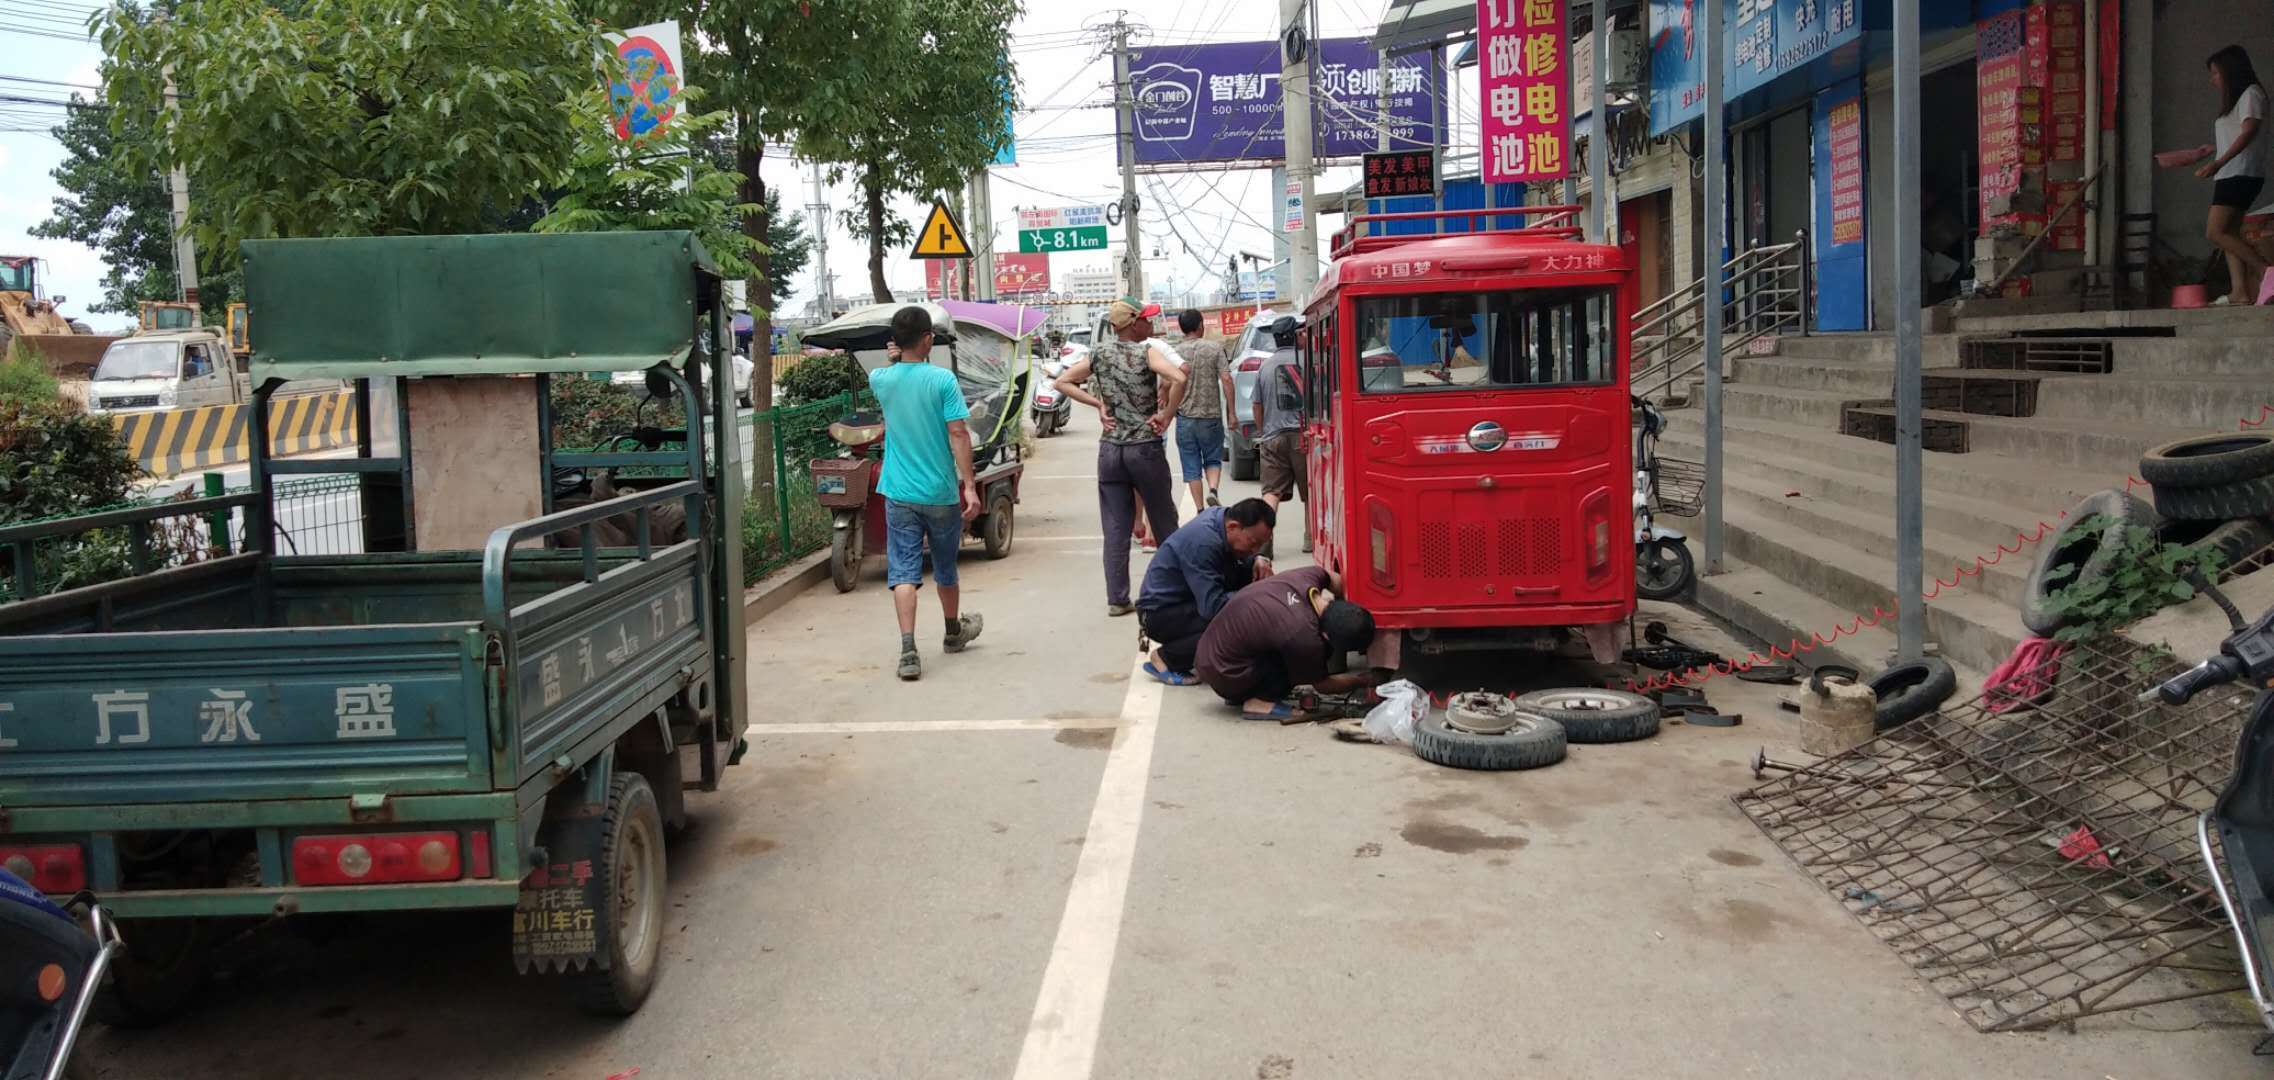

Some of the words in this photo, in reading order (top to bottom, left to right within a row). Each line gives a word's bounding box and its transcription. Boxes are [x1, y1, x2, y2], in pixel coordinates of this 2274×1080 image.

[1486, 0, 1526, 177] 订做电池
[1522, 0, 1562, 175] 检修电池
[1054, 230, 1078, 248] 8.1
[1081, 235, 1099, 247] km
[1371, 260, 1432, 279] 中国梦
[1541, 253, 1606, 272] 大力神
[0, 683, 398, 748] 方永盛
